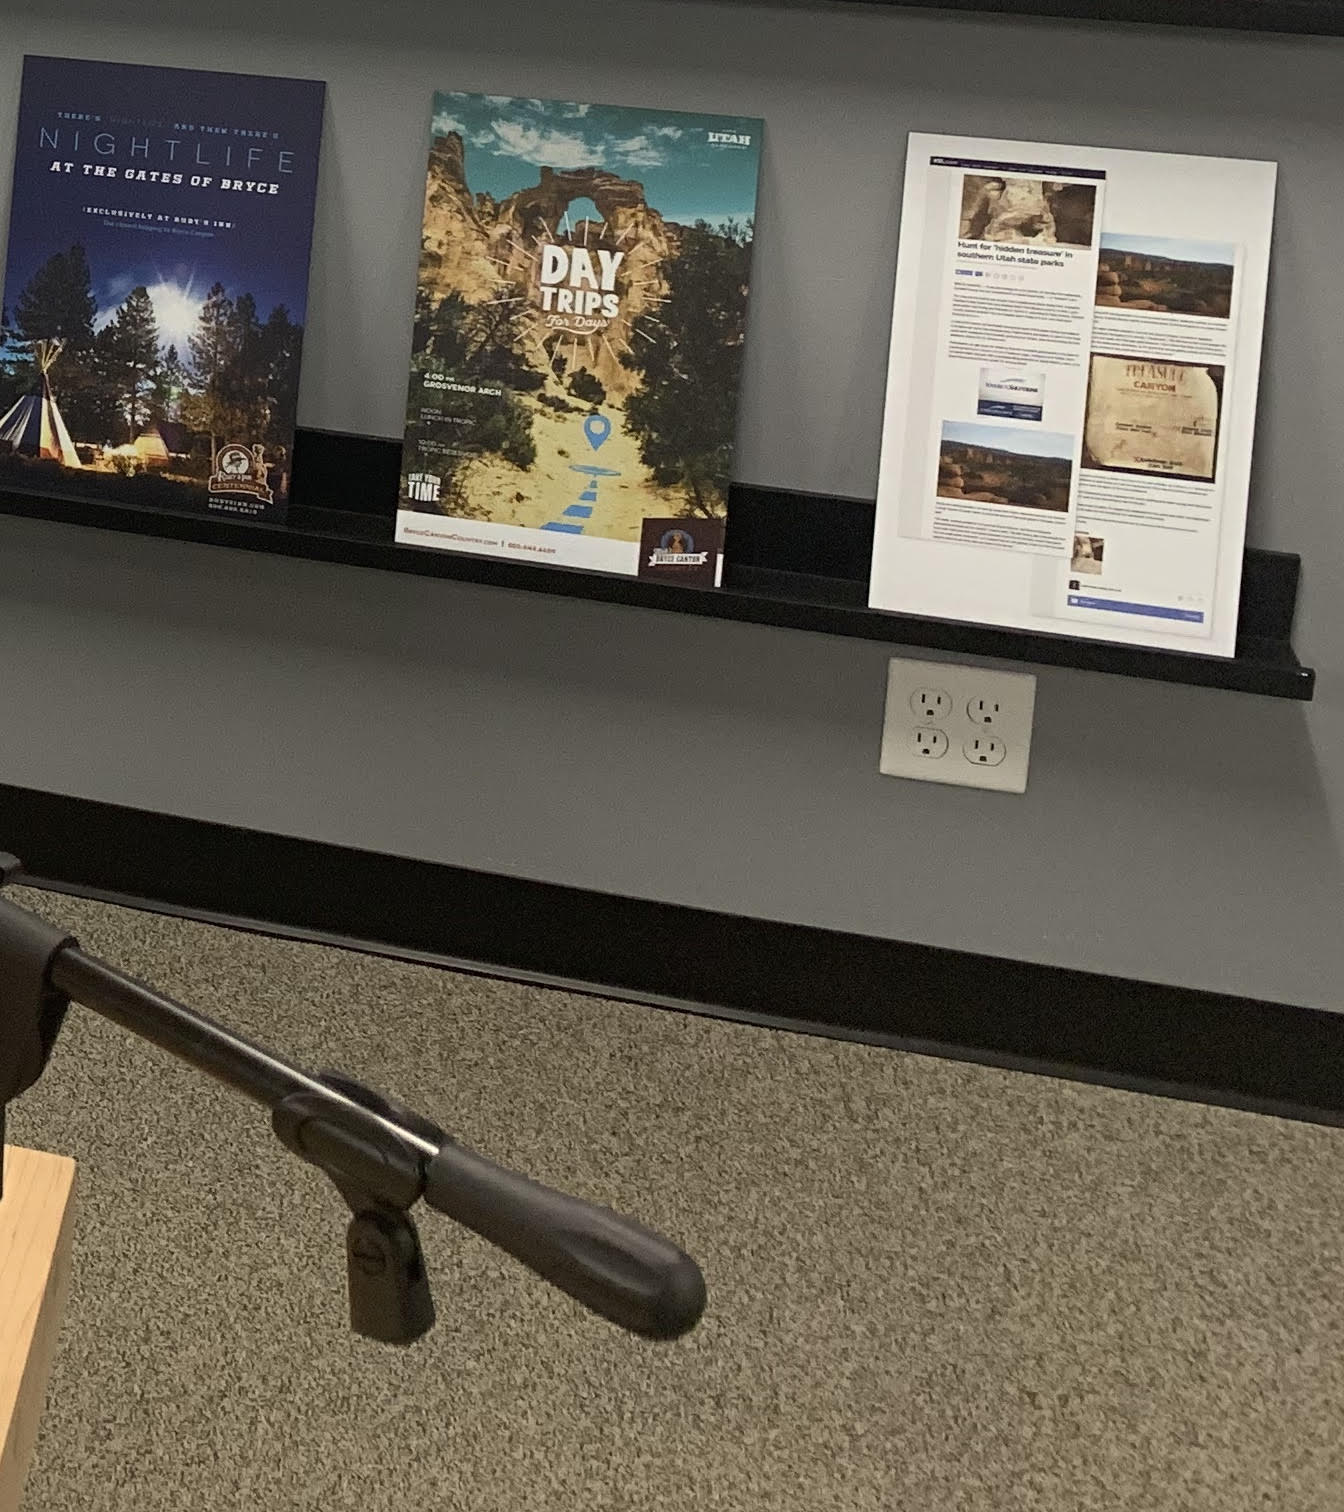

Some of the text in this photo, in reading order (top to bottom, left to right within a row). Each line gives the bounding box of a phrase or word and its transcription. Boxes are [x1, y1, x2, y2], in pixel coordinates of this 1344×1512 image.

[707, 131, 751, 146] UTAH
[39, 127, 295, 174] NIGHTLIFE
[50, 161, 280, 195] AT THE GATES OF BRYCE
[157, 214, 170, 223] AT
[958, 242, 1073, 258] Hunt for in
[957, 251, 1064, 267] southern Utah state parks
[541, 244, 625, 291] DAY
[539, 286, 620, 319] TRIPS
[545, 315, 609, 328] For Days
[423, 381, 502, 396] GROSVENOR ARCH
[1134, 380, 1176, 393] CANYON
[408, 473, 423, 482] TAKE
[408, 482, 441, 501] TIME
